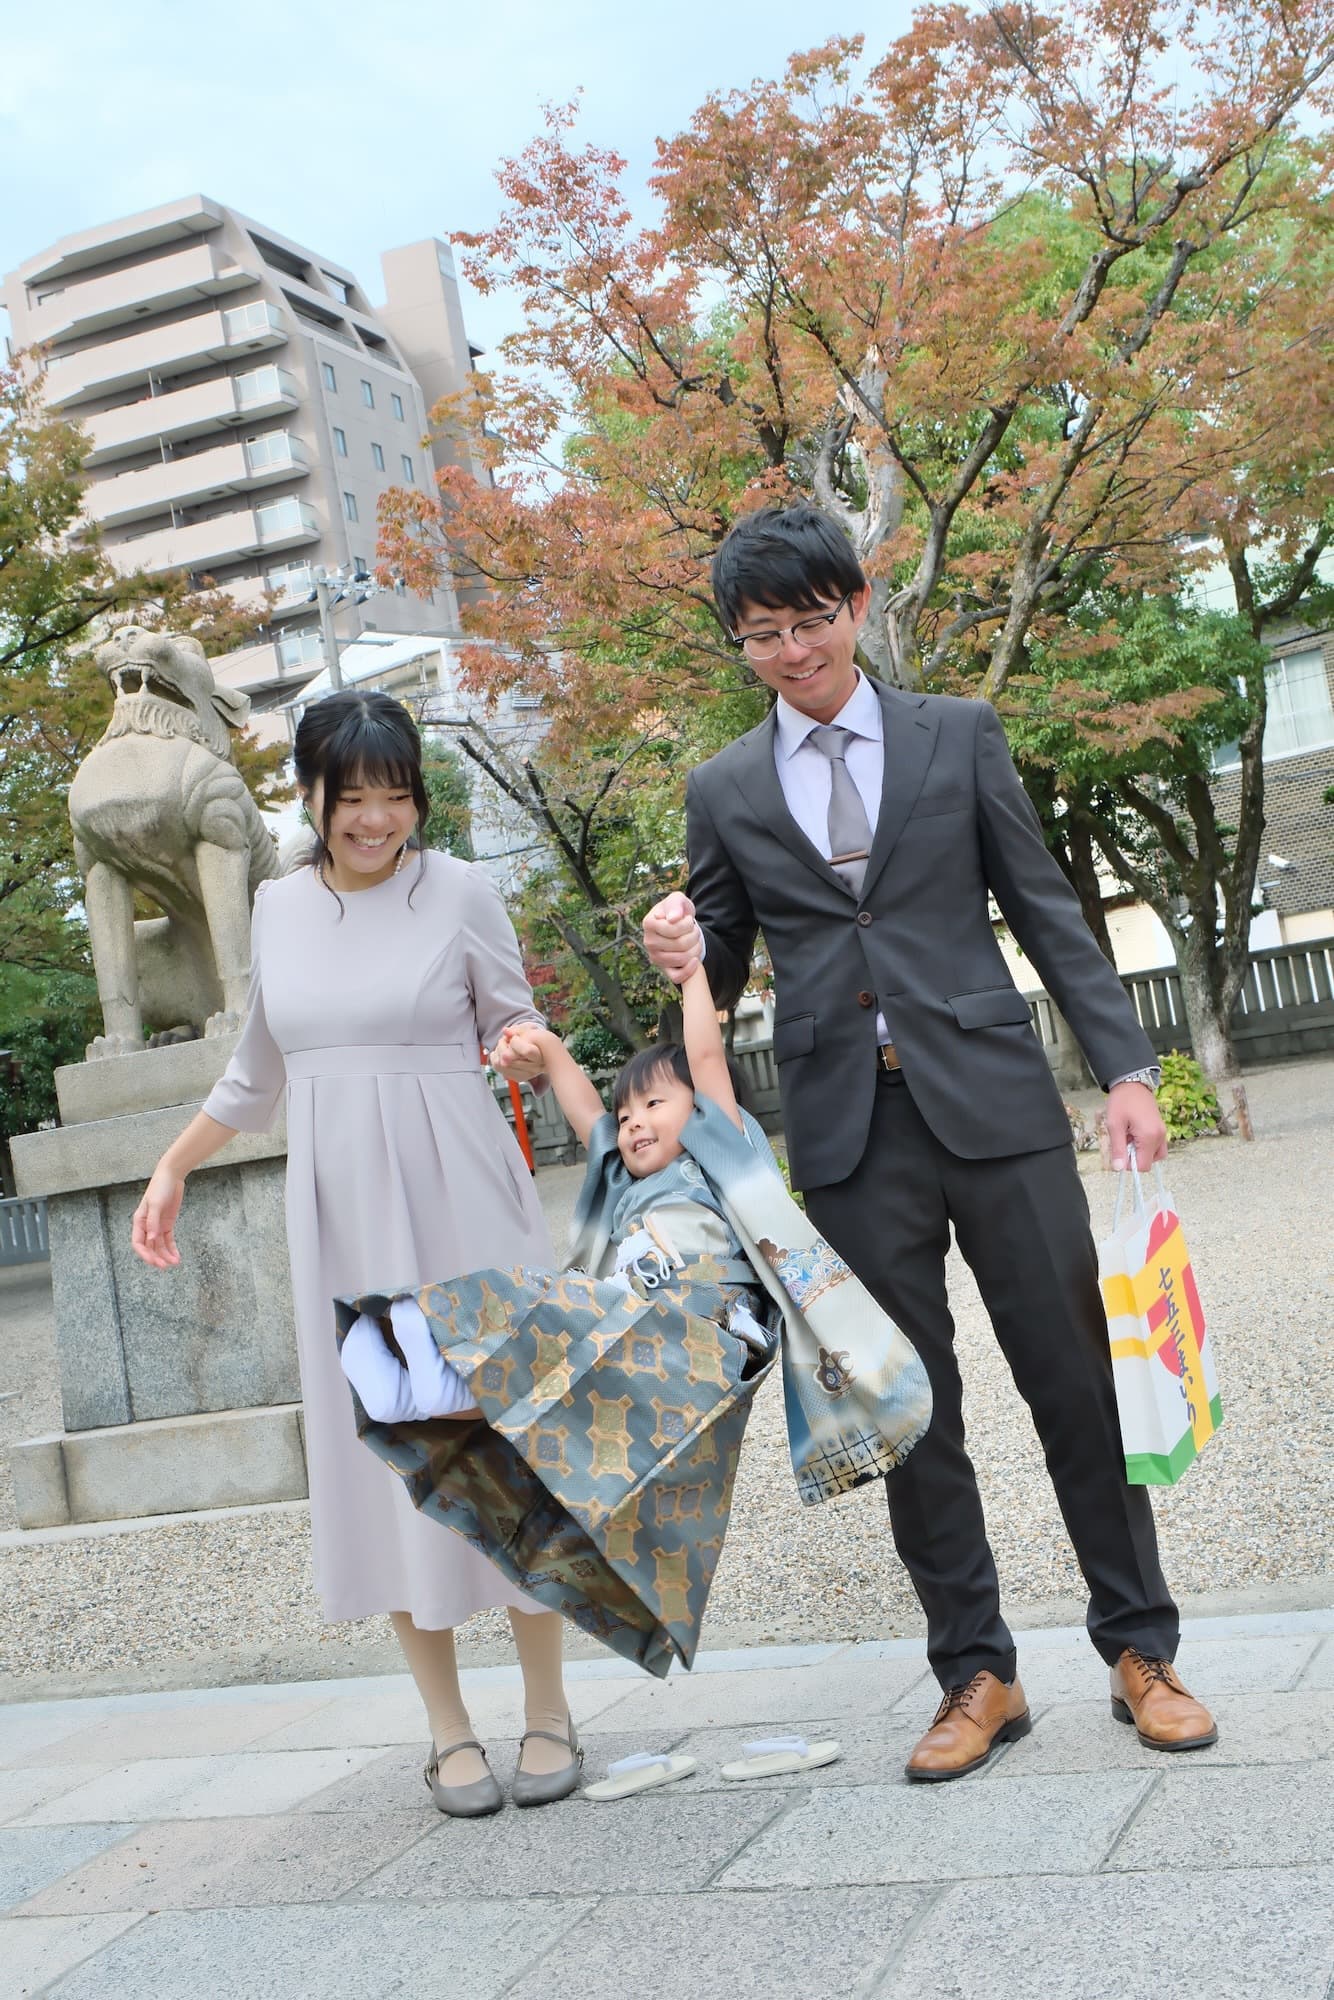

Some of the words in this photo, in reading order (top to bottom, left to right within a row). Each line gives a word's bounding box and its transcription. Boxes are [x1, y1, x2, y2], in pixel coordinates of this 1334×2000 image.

[1159, 1267, 1197, 1426] 七五三まいり
